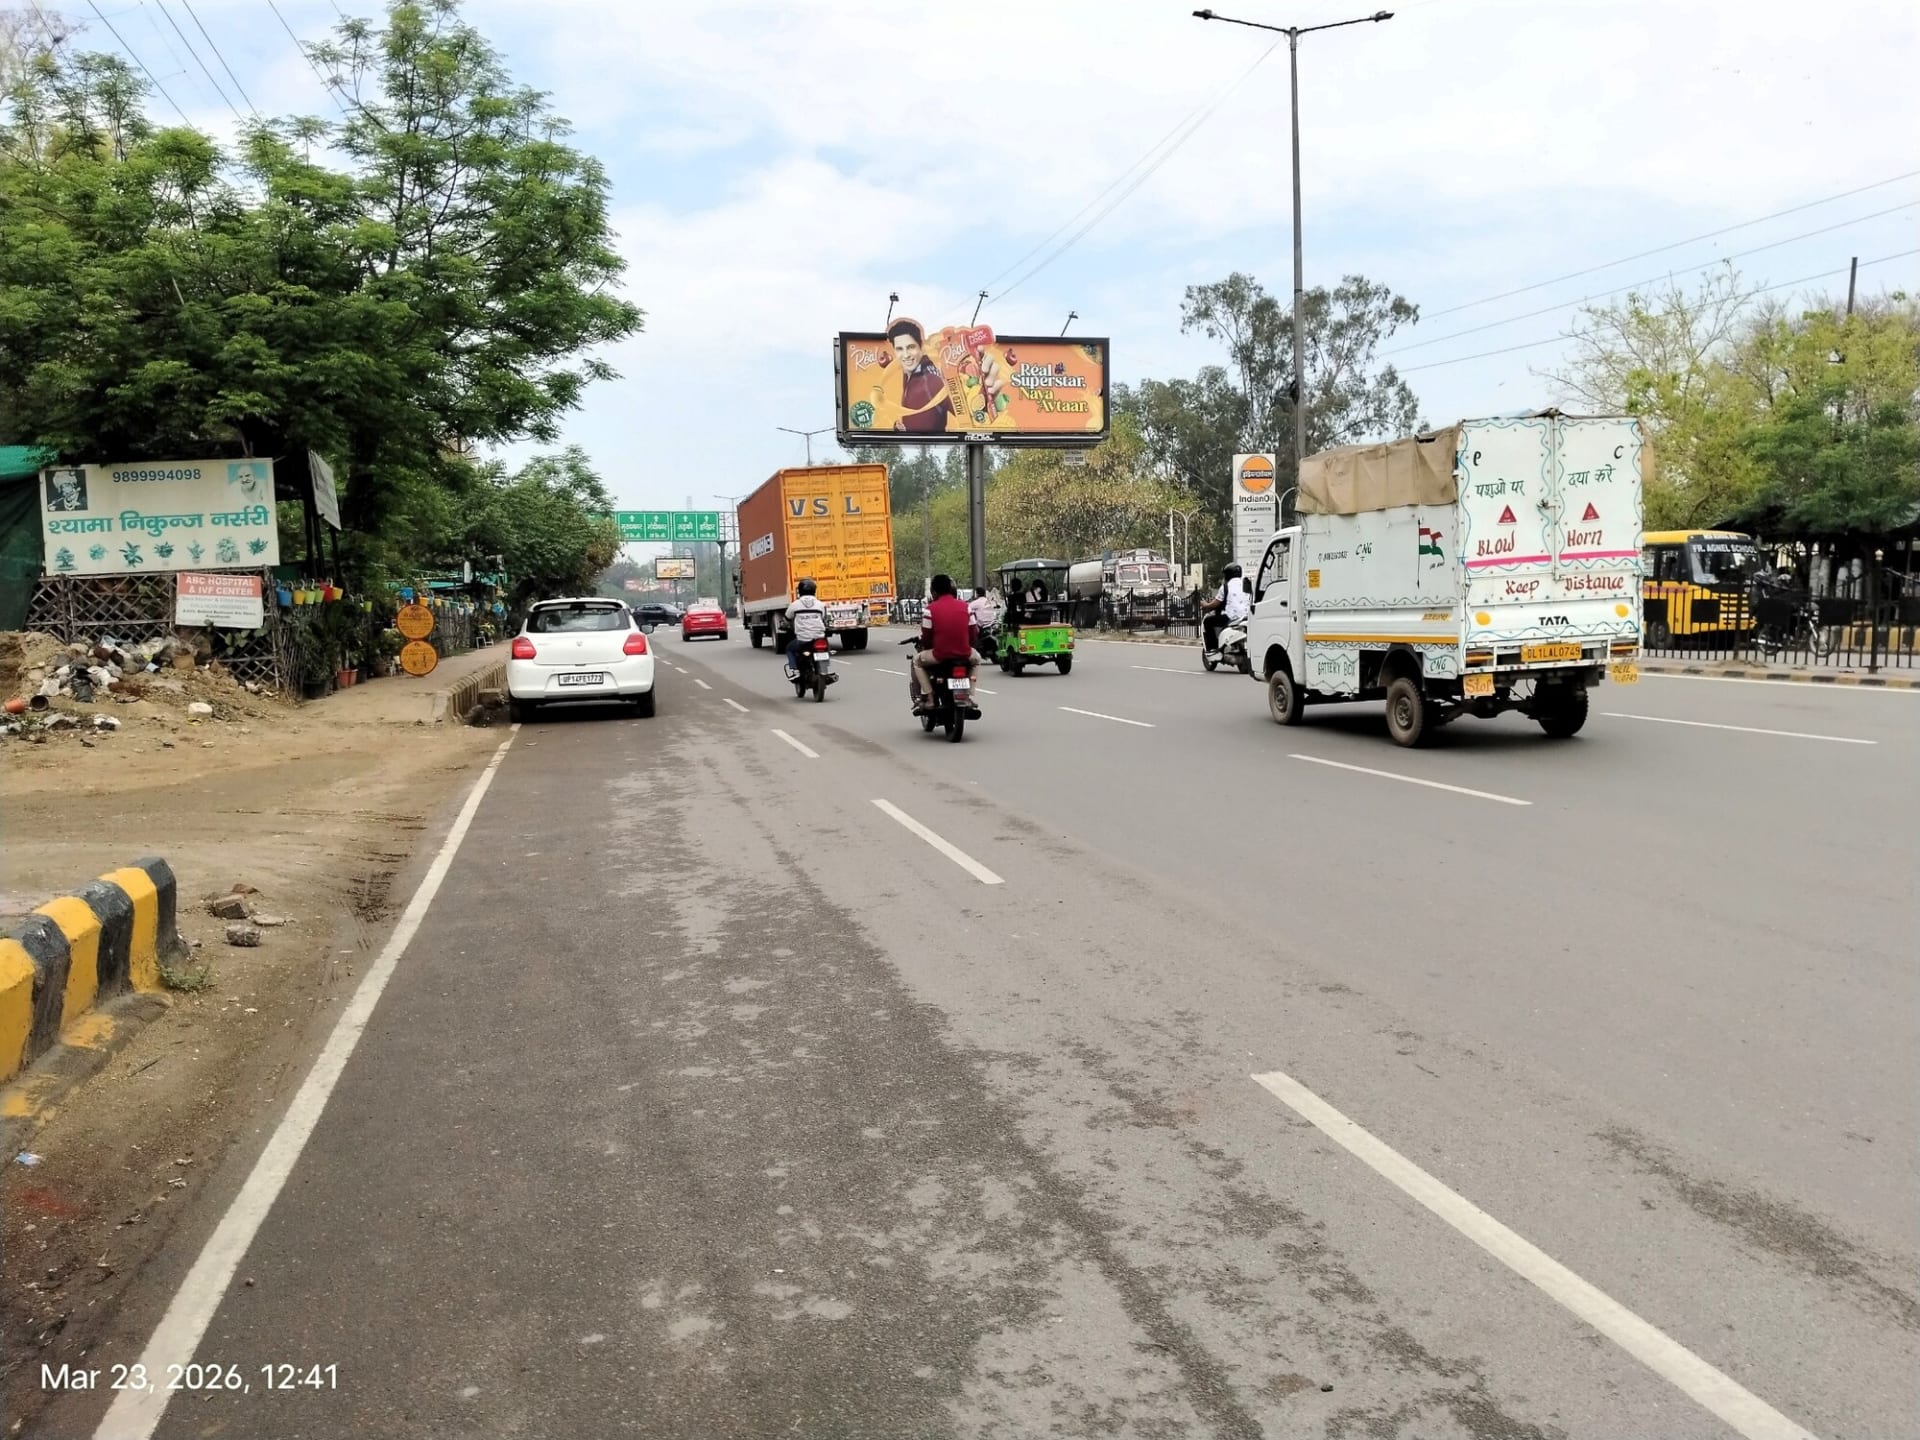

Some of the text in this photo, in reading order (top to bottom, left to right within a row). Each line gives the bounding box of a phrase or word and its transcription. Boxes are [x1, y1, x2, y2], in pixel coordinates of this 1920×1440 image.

[1011, 374, 1087, 389] Superstar.
[1019, 388, 1055, 401] Naya
[1037, 400, 1089, 414] Avtaar.
[1613, 445, 1625, 459] C
[112, 468, 202, 483] 9899994098
[1568, 470, 1591, 488] दया
[1510, 479, 1526, 496] पर
[1239, 494, 1274, 503] IndianOil
[48, 504, 270, 537] श्यामा निकुन्ज नर्सरी
[1355, 542, 1373, 556] CNG
[1731, 544, 1758, 554] SCHOOL
[186, 576, 255, 586] ABC HOSPITAL
[870, 582, 890, 594] HORN
[1564, 574, 1625, 592] Distance
[189, 586, 254, 596] & IVF CENTER
[1538, 615, 1570, 626] TATA
[1317, 661, 1356, 677] BATTERY BOX
[1430, 659, 1447, 672] CNG
